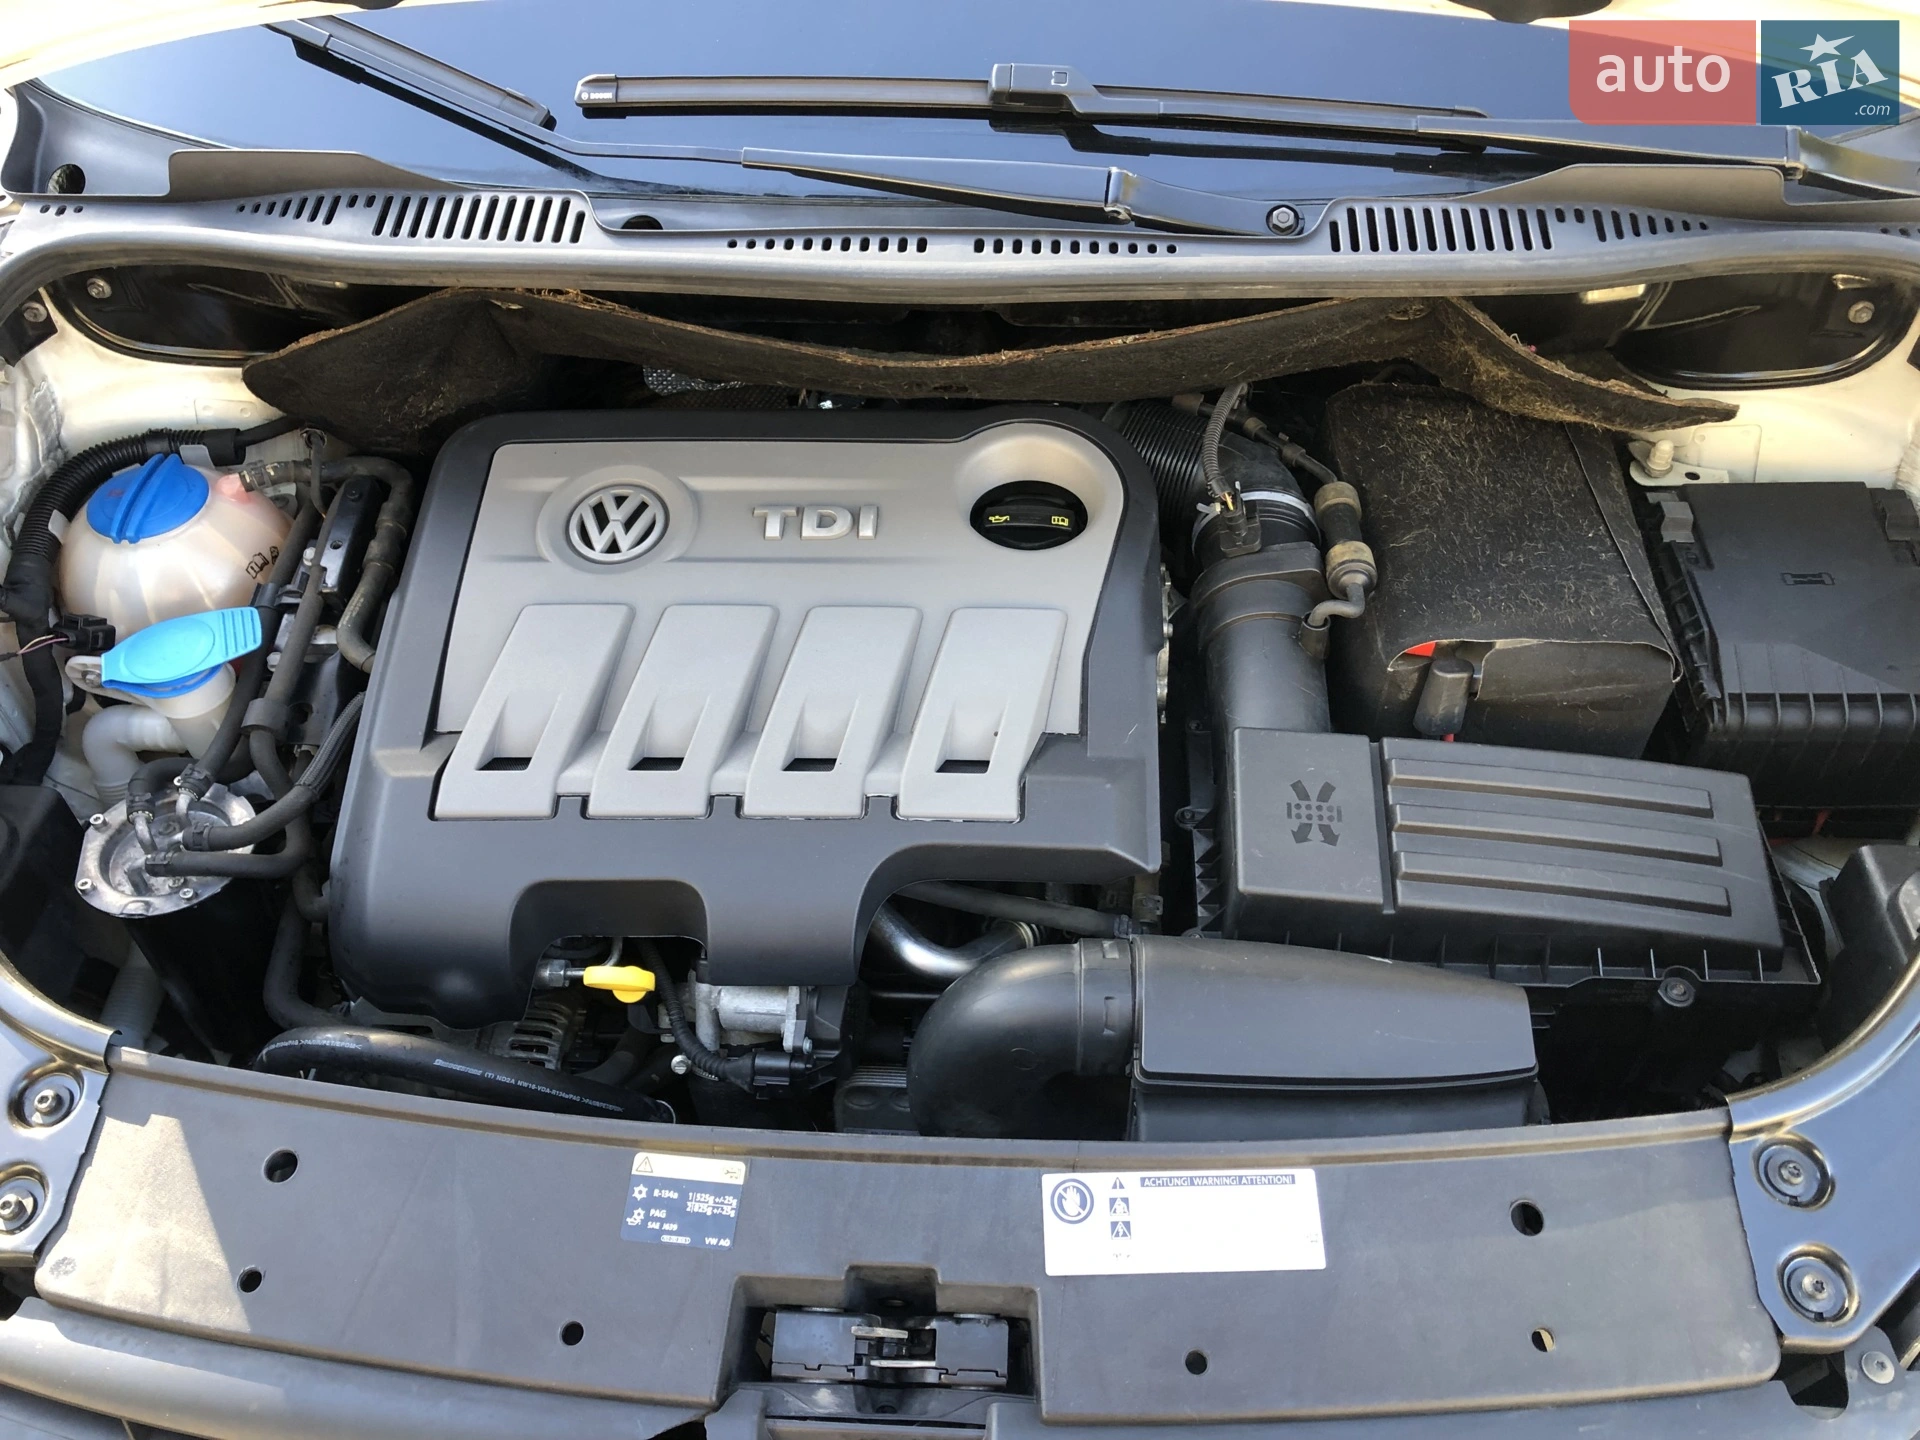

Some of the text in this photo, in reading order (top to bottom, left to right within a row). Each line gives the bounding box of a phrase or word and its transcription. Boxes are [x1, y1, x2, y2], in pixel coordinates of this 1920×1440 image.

[753, 504, 879, 541] TDI
[1143, 1174, 1292, 1187] ACHTUNG! WARNING! ATTENTION!
[653, 1188, 679, 1199] R-134a
[649, 1208, 667, 1218] PAG
[647, 1221, 660, 1230] SAE
[704, 1237, 718, 1246] VW
